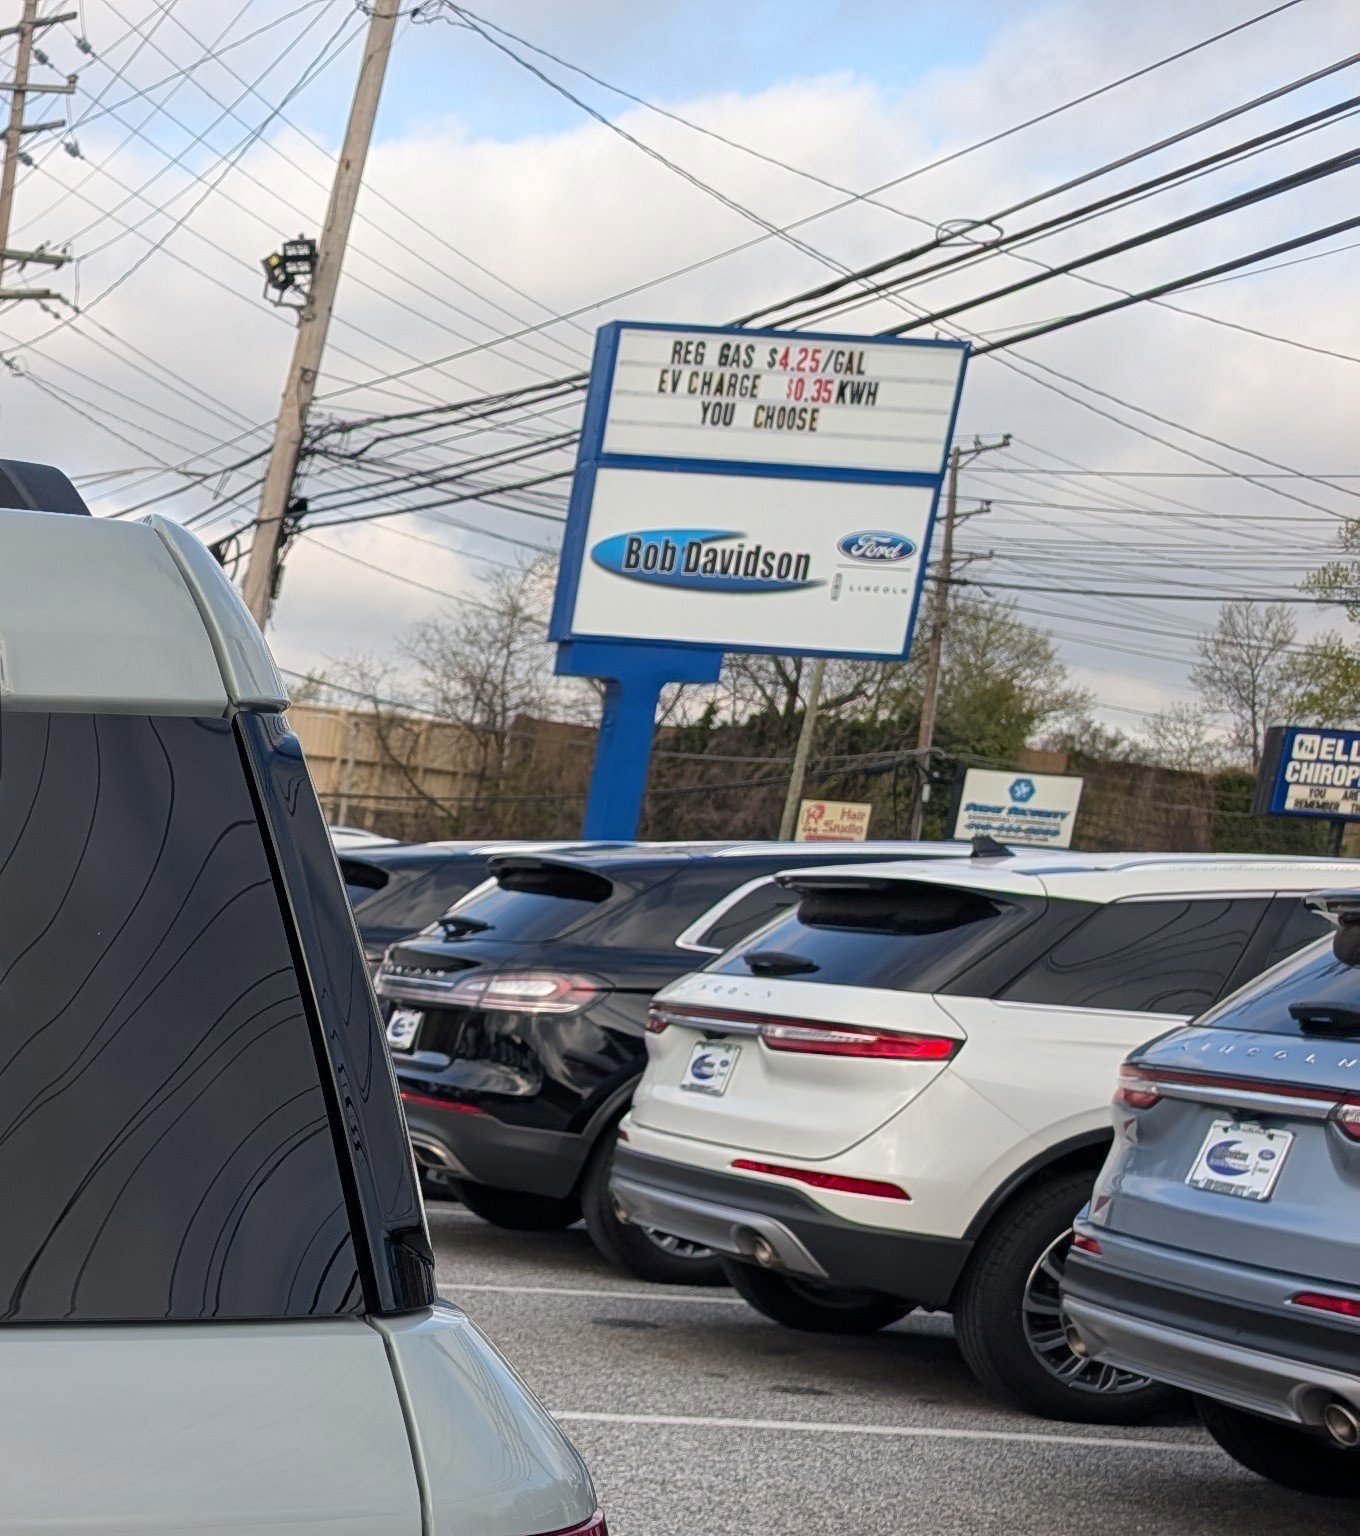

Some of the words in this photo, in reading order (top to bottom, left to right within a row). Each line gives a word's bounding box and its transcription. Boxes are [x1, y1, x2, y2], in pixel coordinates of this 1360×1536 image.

[671, 340, 706, 366] REG
[718, 342, 755, 369] GAS
[767, 345, 866, 375] $4.25/GAL
[658, 368, 682, 393] EV
[688, 370, 761, 399] CHARGE
[701, 400, 736, 427] YOU
[753, 403, 821, 433] CHOOSE
[625, 536, 677, 573] Bob
[683, 540, 811, 582] Davidson
